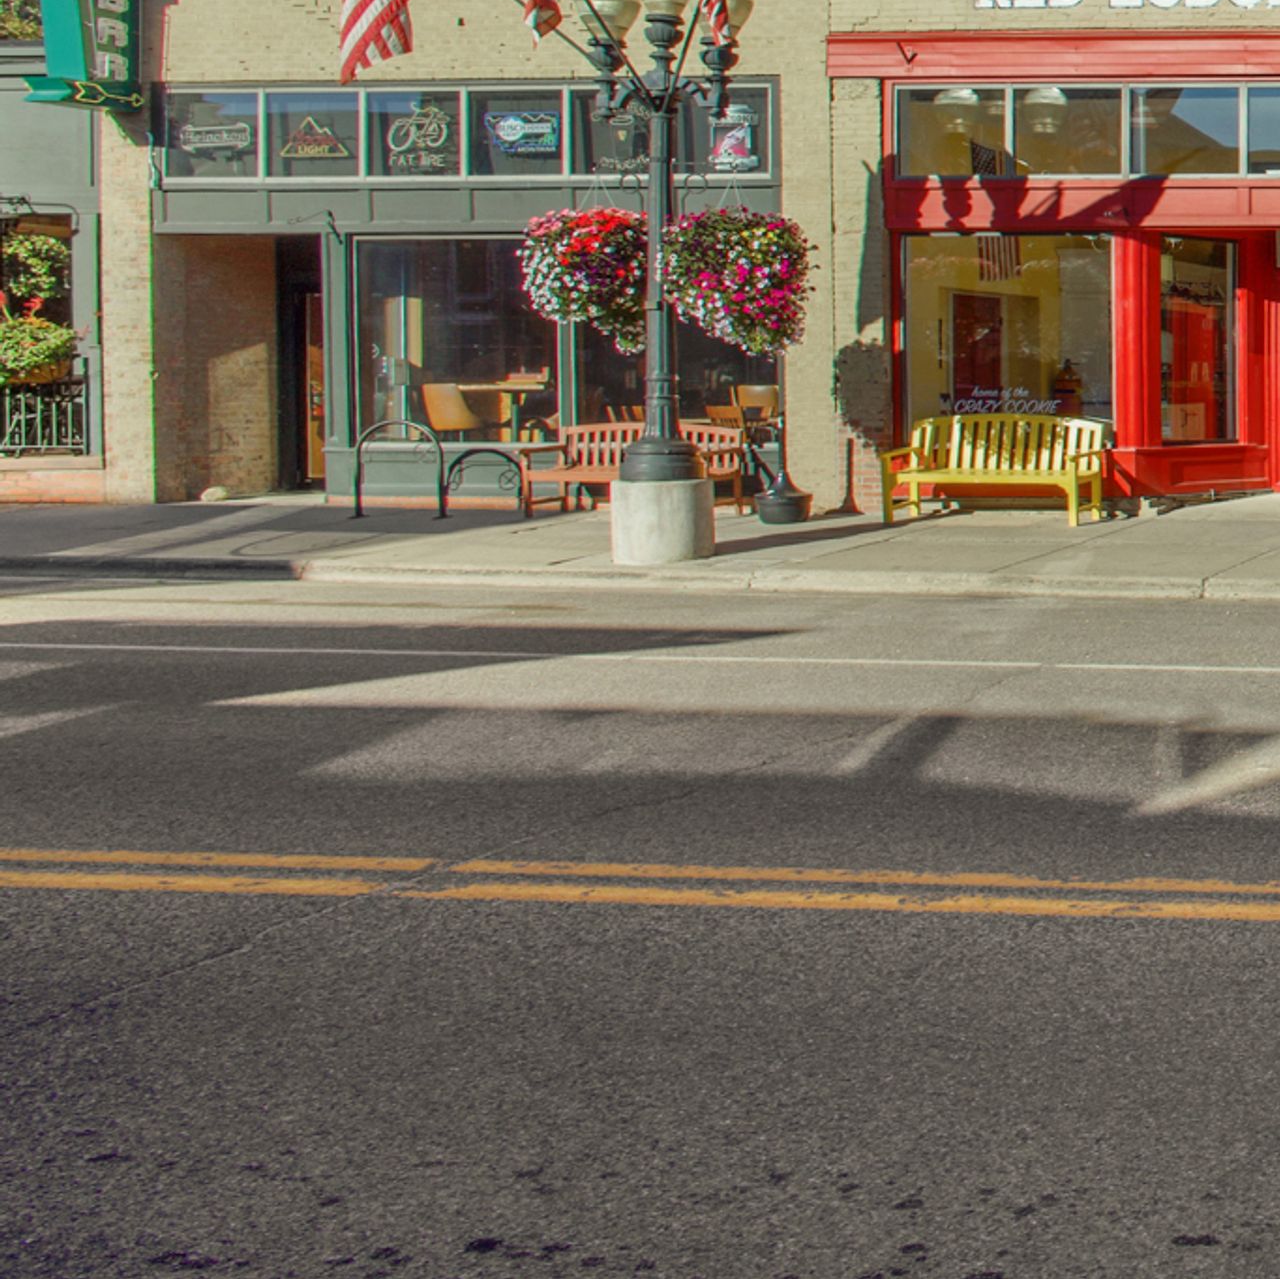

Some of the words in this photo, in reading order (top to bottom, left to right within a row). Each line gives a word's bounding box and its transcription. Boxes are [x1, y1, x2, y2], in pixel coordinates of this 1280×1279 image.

[298, 145, 330, 154] LIGHT
[389, 153, 415, 167] FAT
[972, 385, 998, 397] home
[1013, 386, 1029, 397] the
[954, 399, 1001, 413] CRAZY
[1004, 399, 1062, 413] COOKIE
